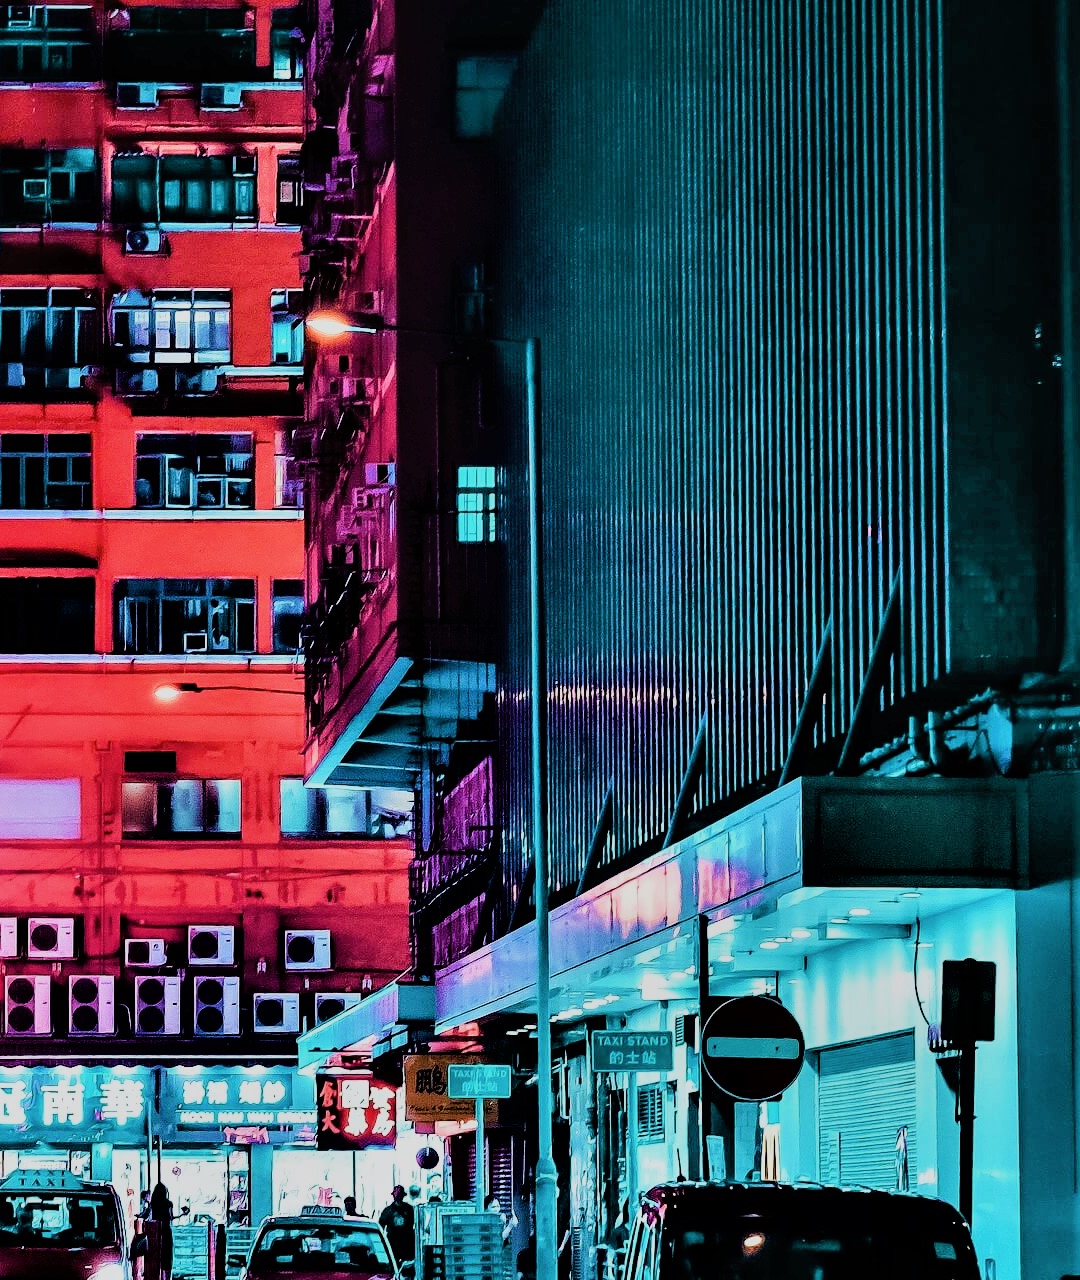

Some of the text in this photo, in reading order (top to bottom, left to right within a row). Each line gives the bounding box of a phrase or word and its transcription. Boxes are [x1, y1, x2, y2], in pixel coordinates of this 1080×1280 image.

[597, 1035, 669, 1047] TAXI STAND
[609, 1050, 657, 1065] 的士站
[18, 1177, 65, 1187] TAXI
